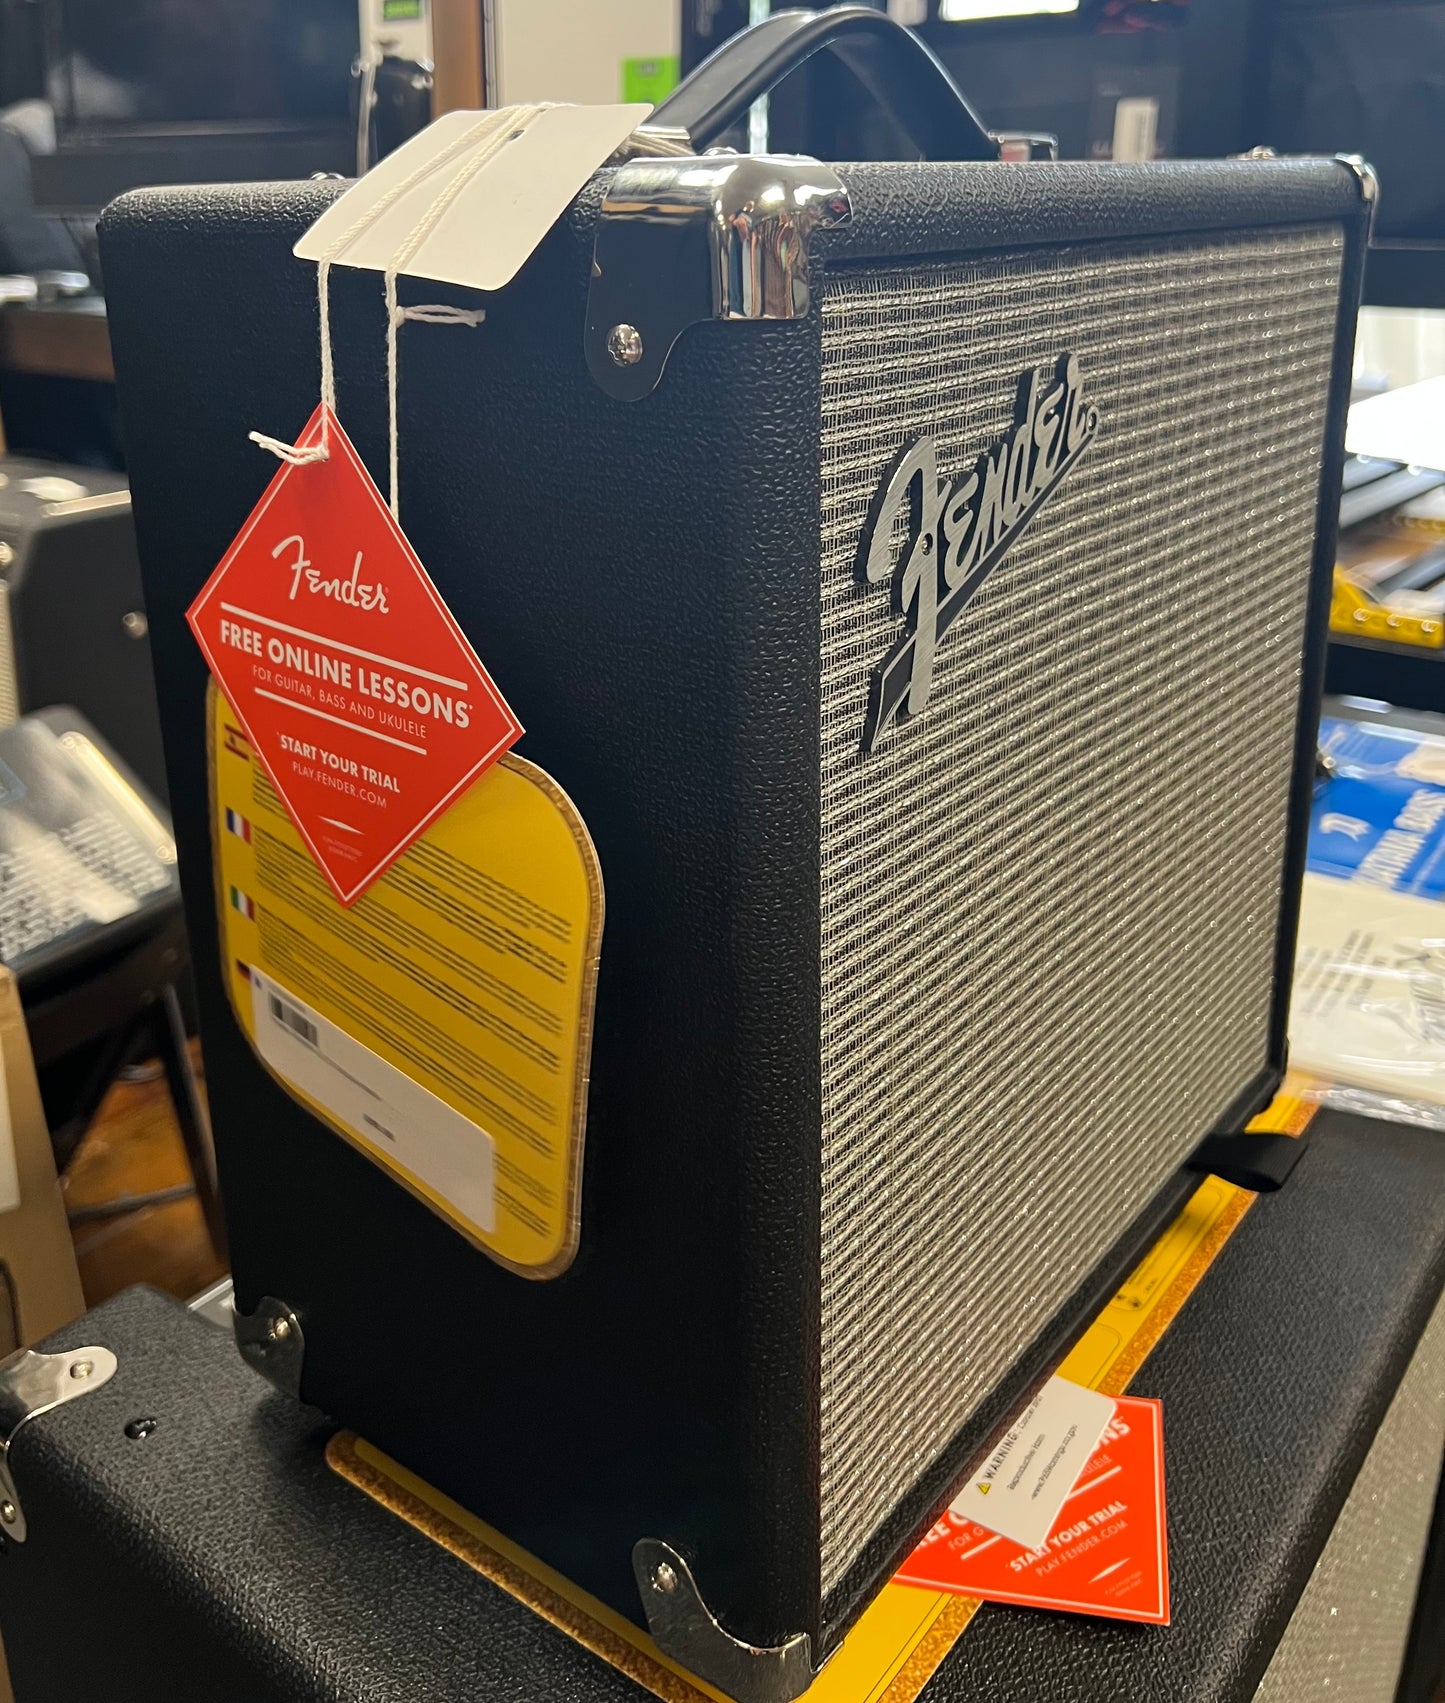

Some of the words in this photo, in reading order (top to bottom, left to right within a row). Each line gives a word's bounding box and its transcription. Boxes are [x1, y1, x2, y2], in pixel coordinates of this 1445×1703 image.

[859, 352, 1096, 728] Fender
[271, 534, 389, 615] Fender
[221, 619, 263, 658] FREE
[267, 638, 352, 689] ONLINE
[252, 664, 272, 683] FOR
[274, 673, 316, 701] GUITAR,
[319, 689, 346, 710] BASS
[349, 701, 375, 720] AND
[379, 710, 427, 739] UKULELE
[291, 761, 388, 809] PLAY.FENDER.COM
[319, 749, 360, 778] YOUR
[361, 764, 401, 794] TRIAL
[1035, 1519, 1128, 1577] PLAY.FENDER.COM
[1049, 1520, 1092, 1548] YOUR
[1087, 1500, 1128, 1527] TRIAL
